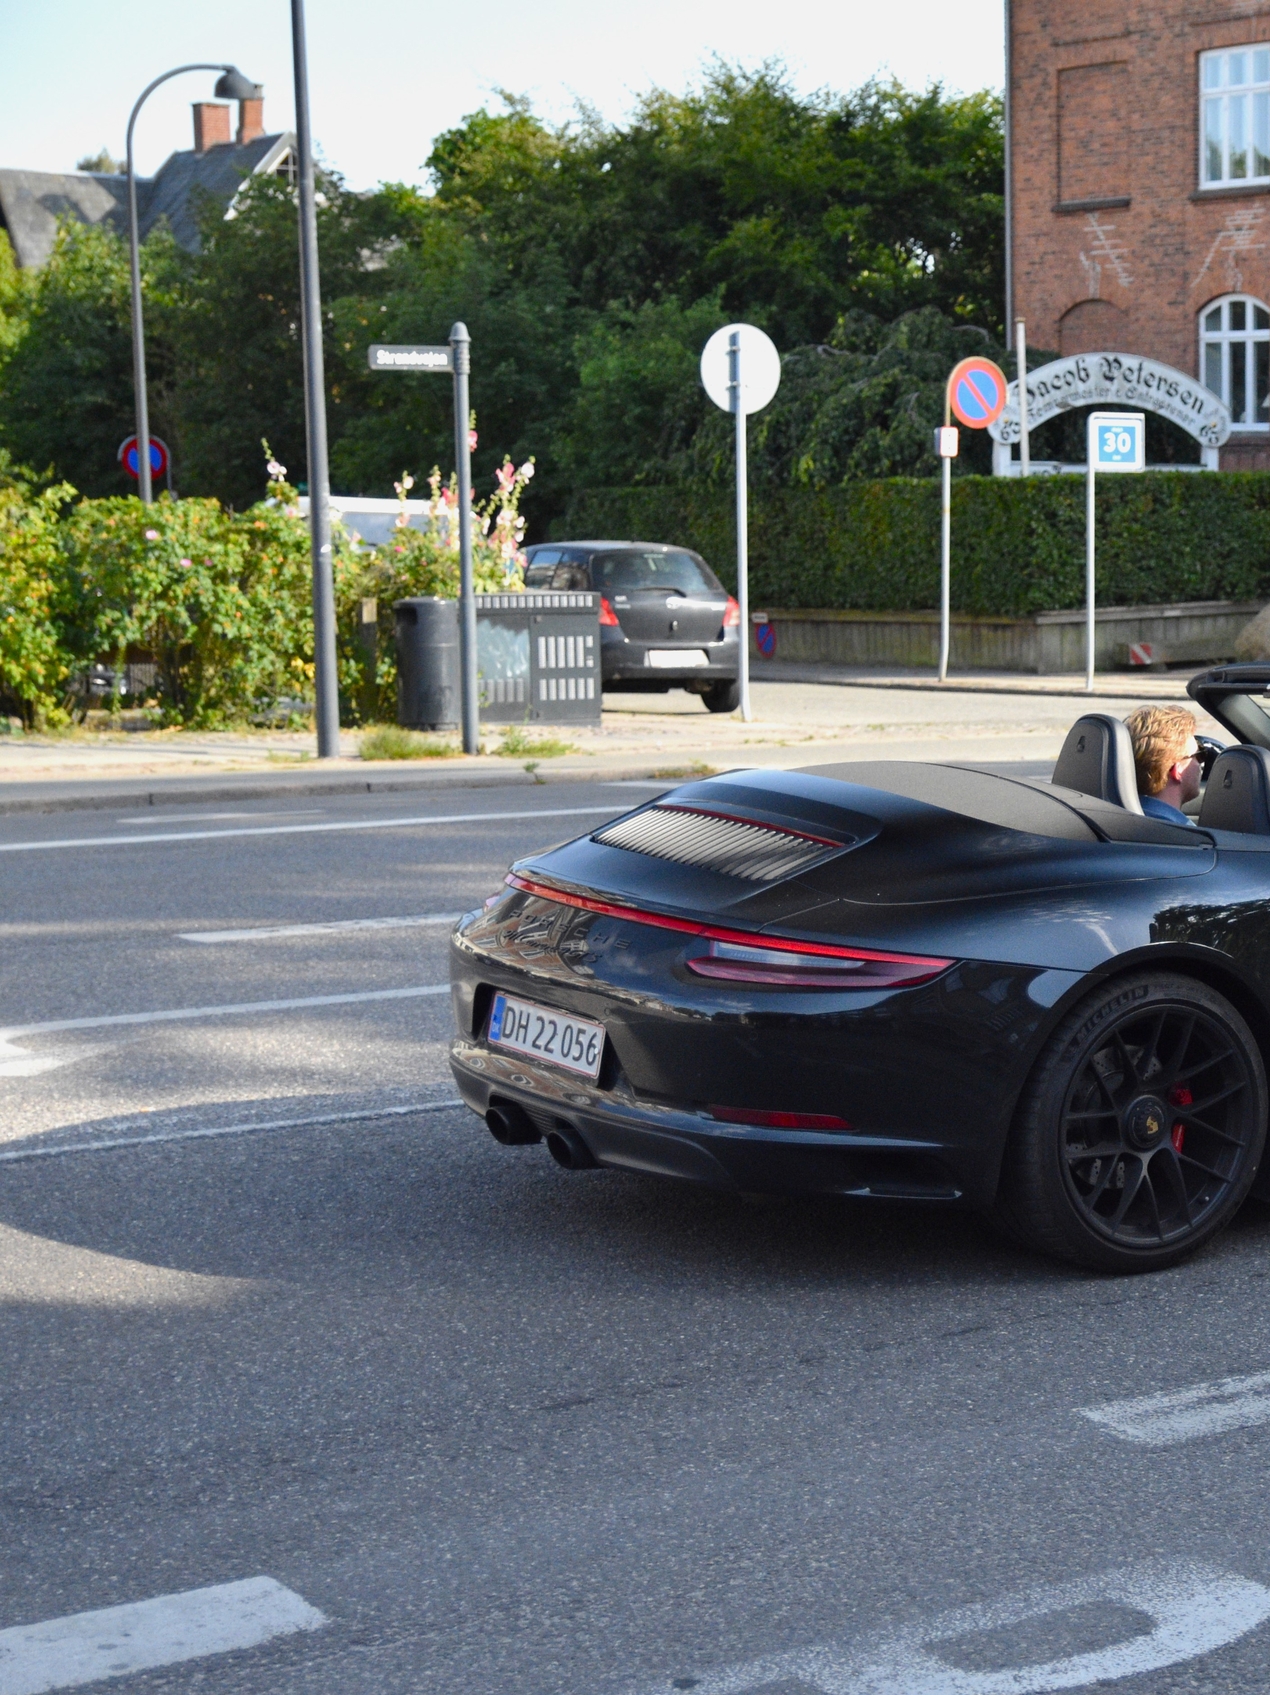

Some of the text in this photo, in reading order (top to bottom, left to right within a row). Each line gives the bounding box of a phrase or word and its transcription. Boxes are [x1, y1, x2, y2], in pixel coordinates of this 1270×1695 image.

[1012, 355, 1204, 414] Jacob Petersen
[1103, 432, 1132, 453] 30
[509, 909, 632, 950] PORSCHE
[502, 1005, 599, 1067] DH 22 056
[1075, 984, 1149, 1043] MICHELIN
